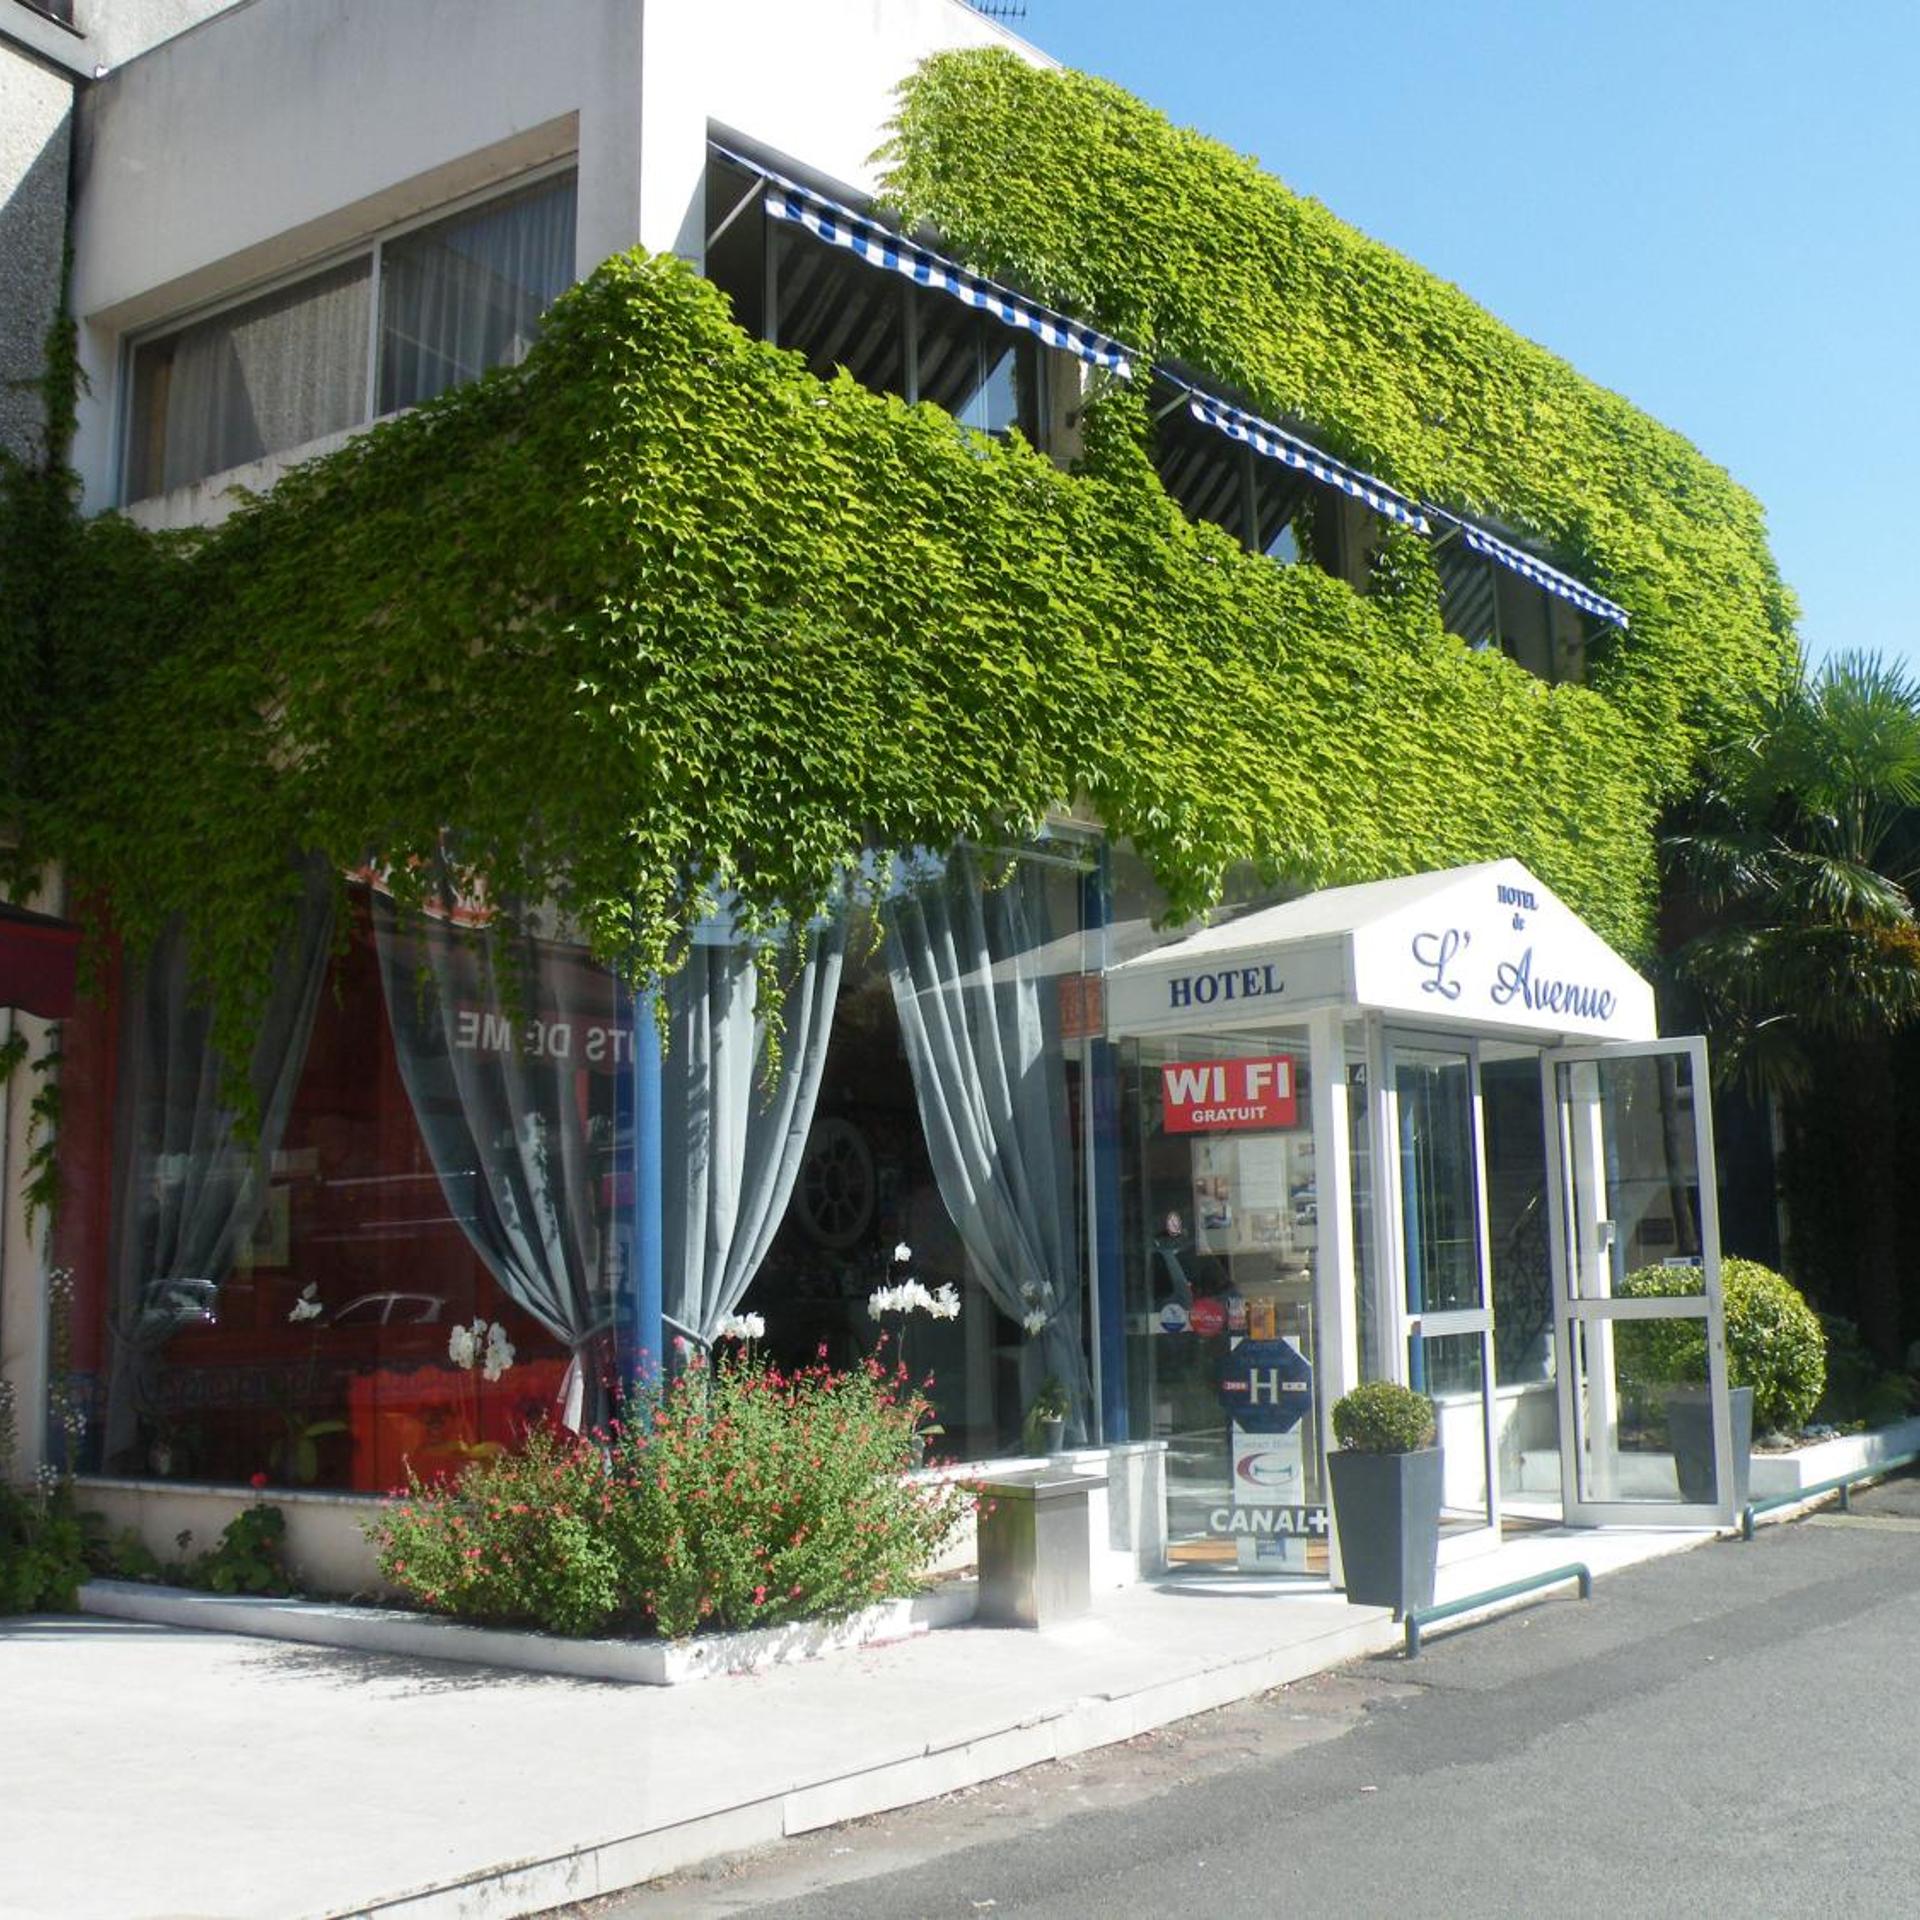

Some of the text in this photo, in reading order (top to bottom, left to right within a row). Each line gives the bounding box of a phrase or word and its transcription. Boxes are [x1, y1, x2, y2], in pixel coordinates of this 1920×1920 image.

[1497, 885, 1537, 910] HOTEL
[1513, 913, 1524, 931] de
[1169, 965, 1284, 1007] HOTEL
[1413, 929, 1616, 1020] L' Avenue
[1165, 1062, 1290, 1105] WI FI
[1192, 1106, 1266, 1122] GRATUIT
[1249, 1367, 1279, 1405] H
[1211, 1509, 1328, 1533] CANAL+
